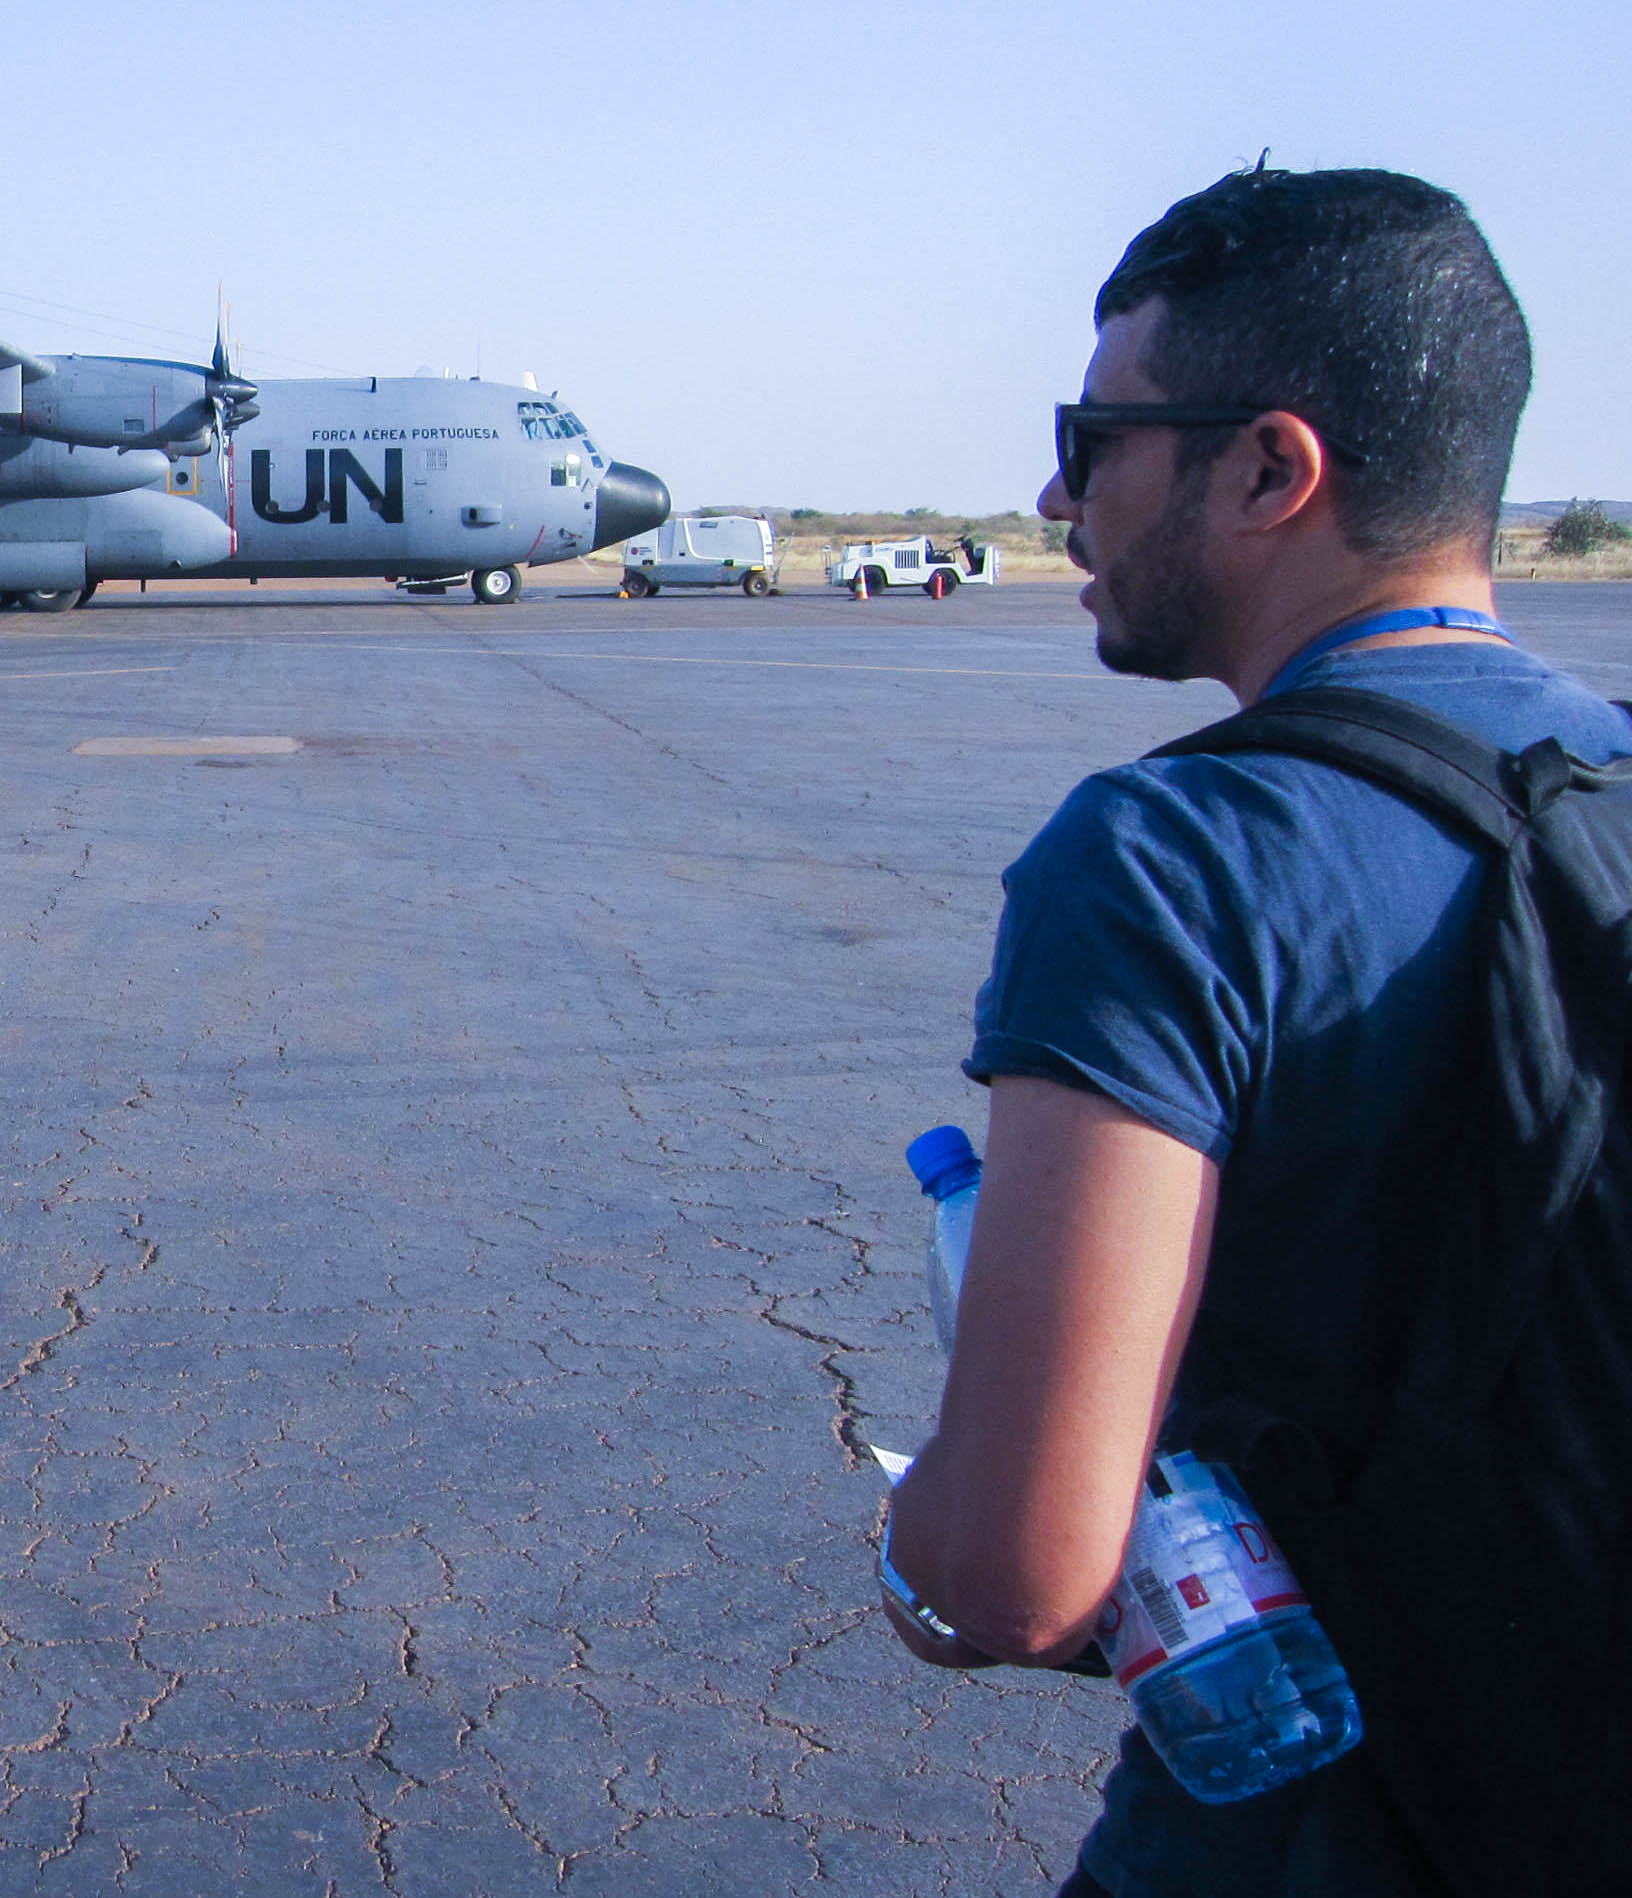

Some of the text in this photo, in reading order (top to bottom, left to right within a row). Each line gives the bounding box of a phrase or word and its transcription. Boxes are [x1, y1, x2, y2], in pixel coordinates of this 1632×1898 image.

[312, 430, 356, 441] FORÇA
[412, 428, 500, 440] PORTUGUESA
[251, 448, 403, 524] UN
